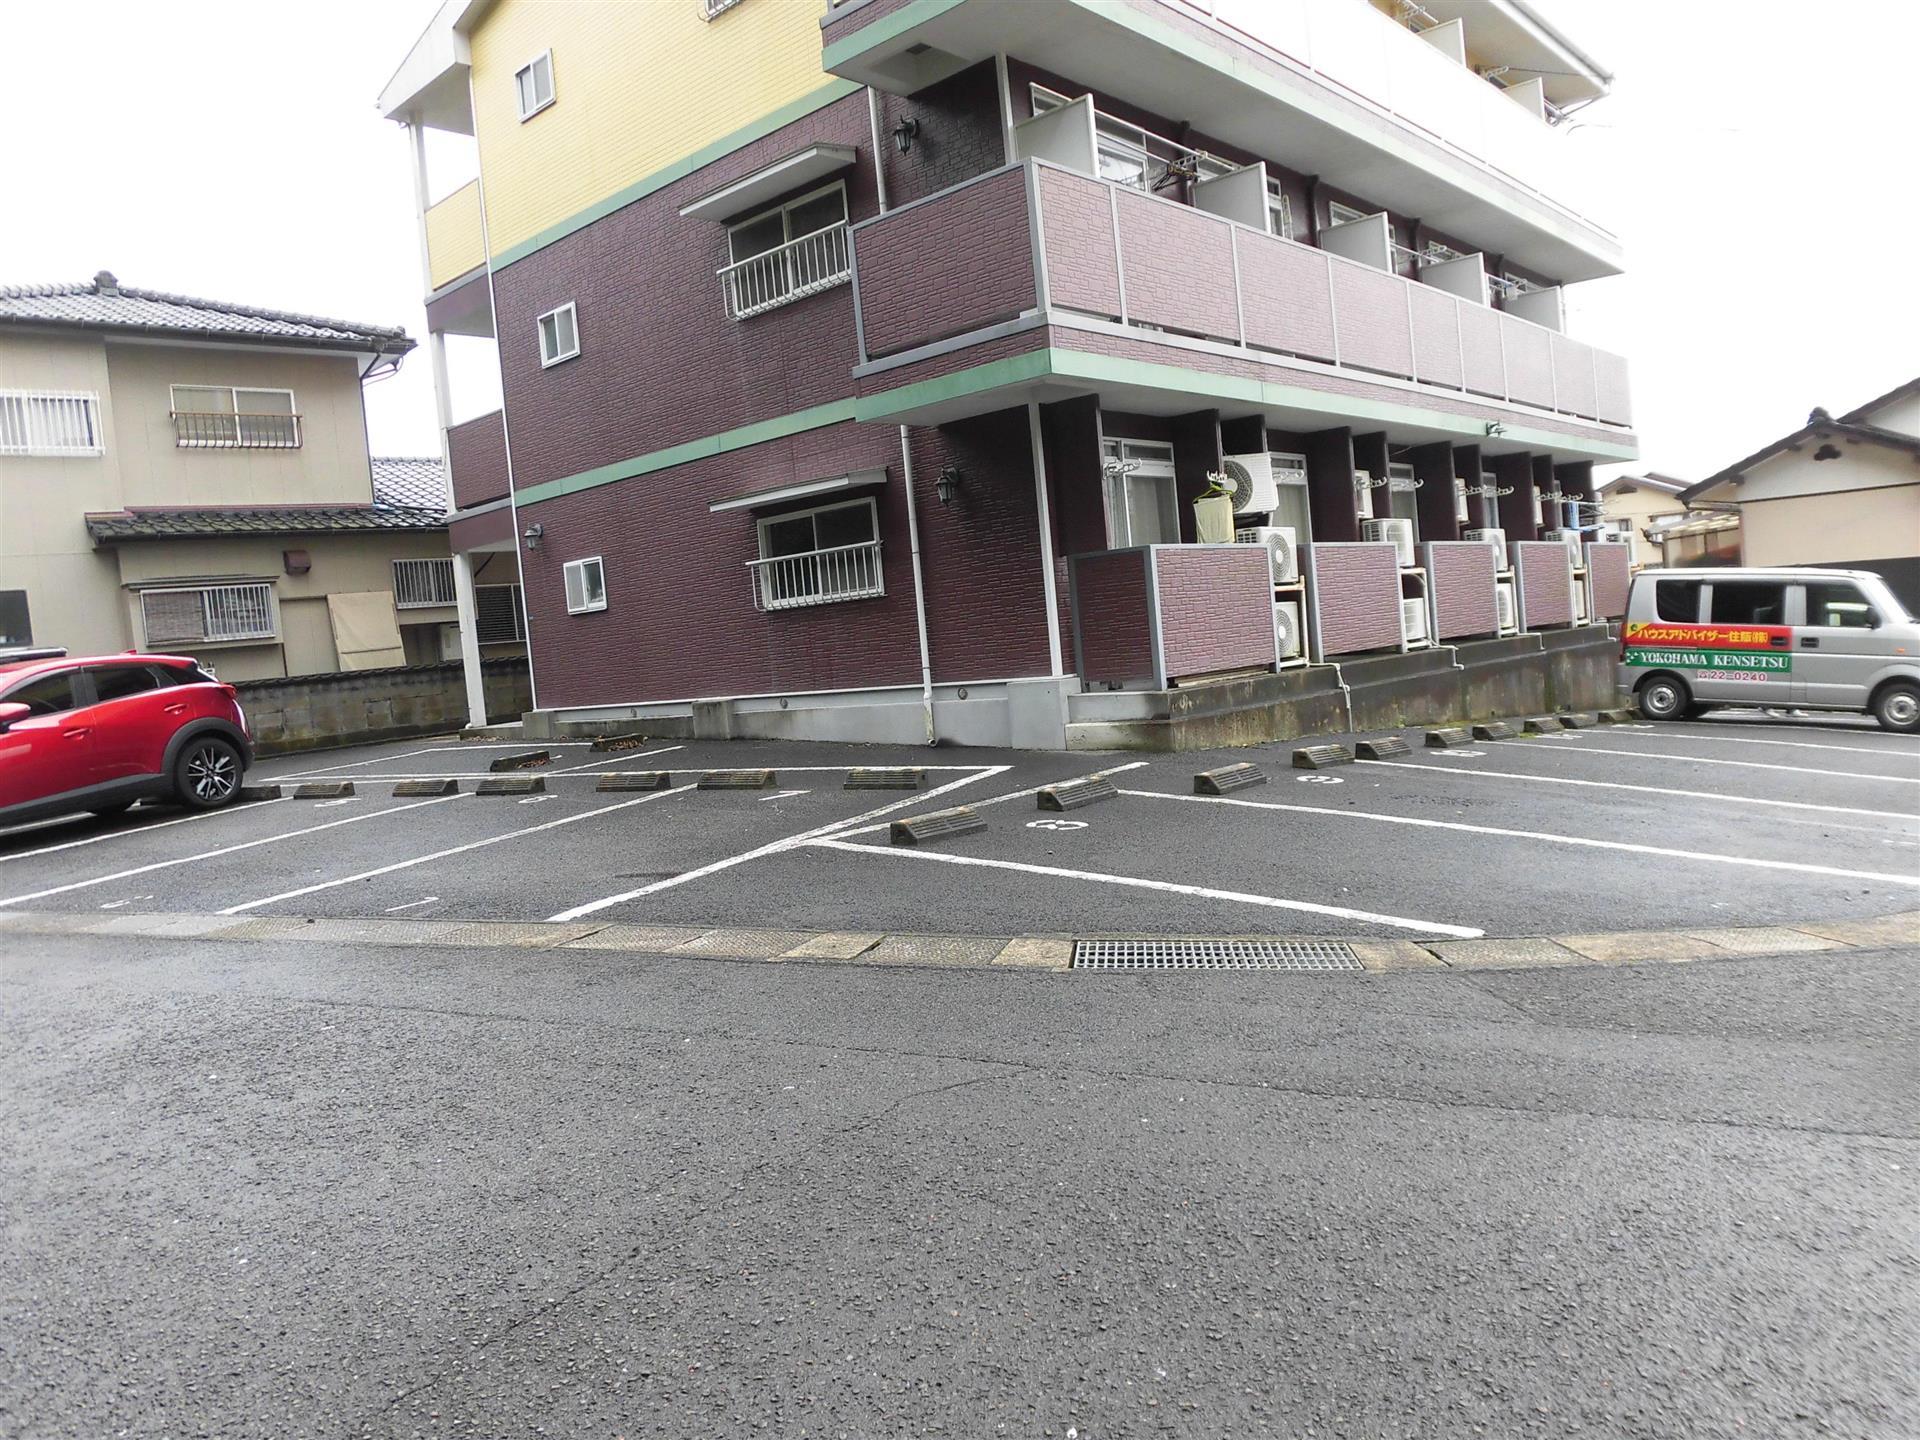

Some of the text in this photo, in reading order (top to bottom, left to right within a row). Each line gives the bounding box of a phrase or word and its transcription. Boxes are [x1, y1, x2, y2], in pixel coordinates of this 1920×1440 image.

[1641, 652, 1788, 668] YOKOHAMA KENSETSU
[759, 790, 812, 800] 7
